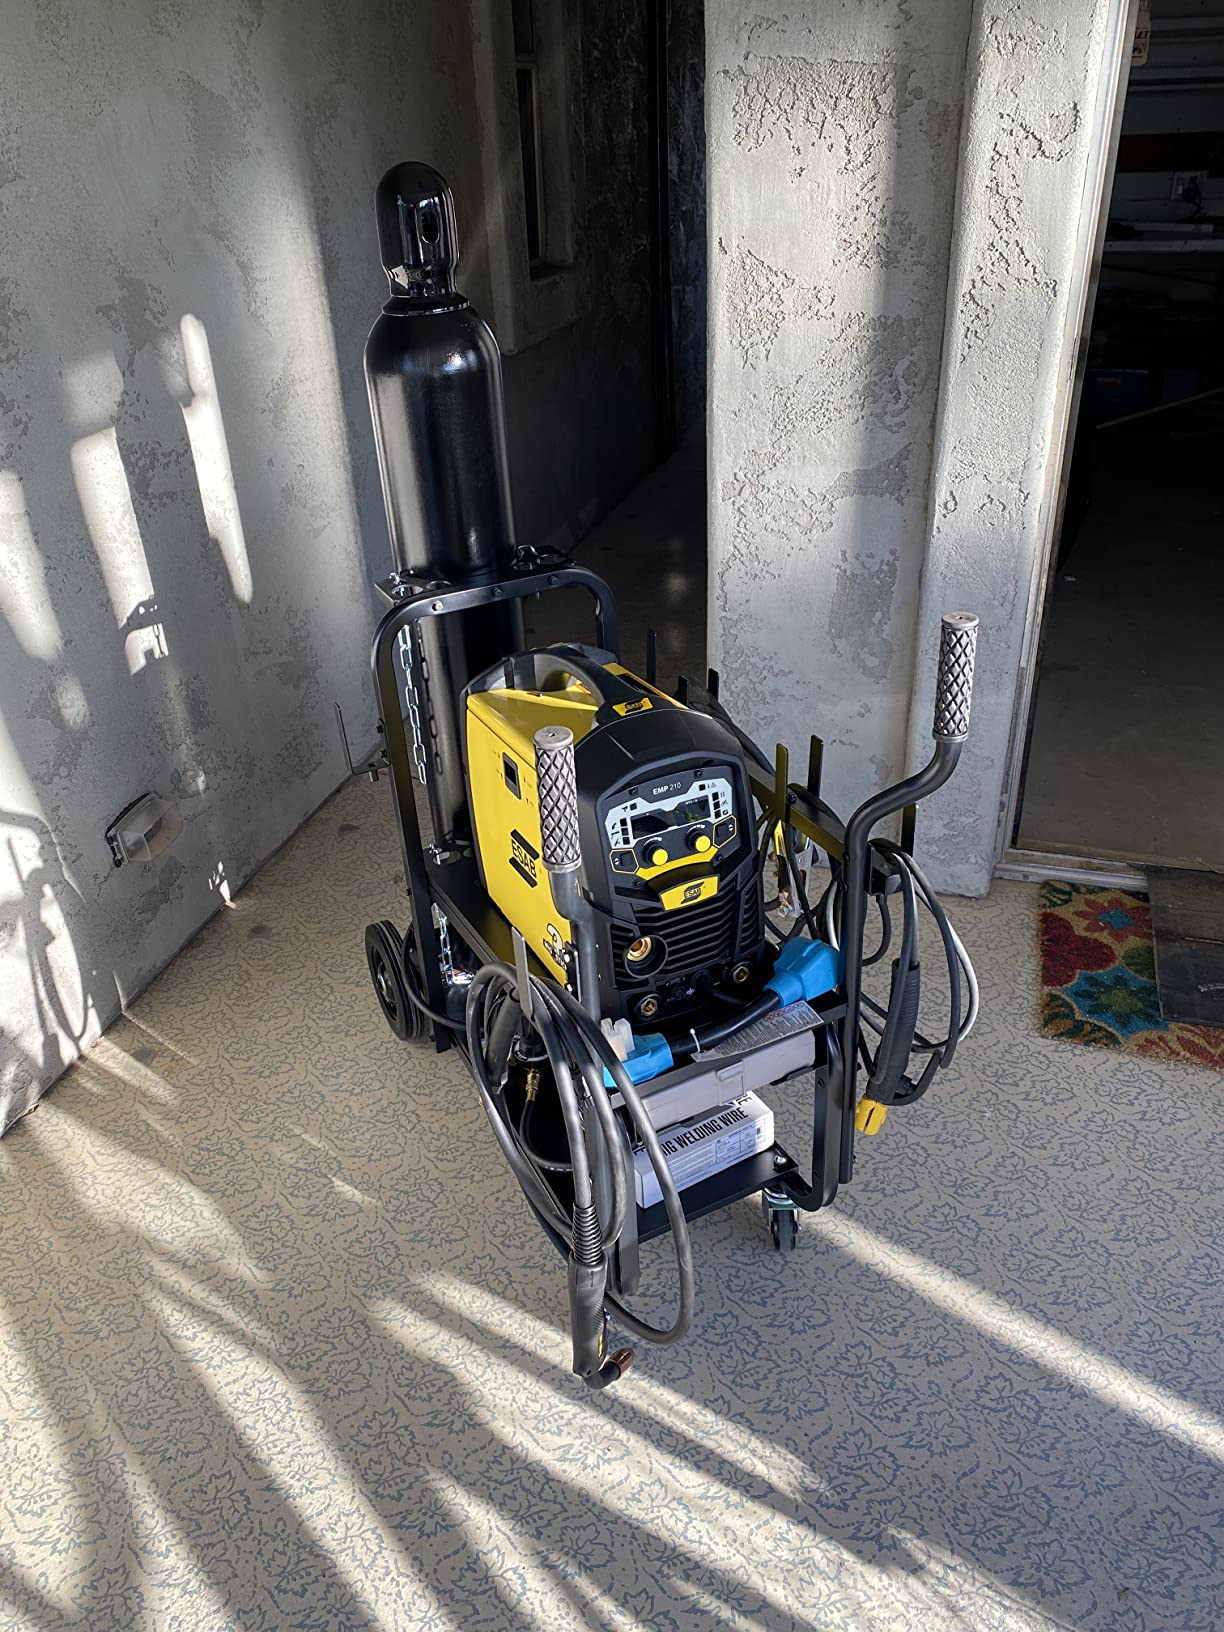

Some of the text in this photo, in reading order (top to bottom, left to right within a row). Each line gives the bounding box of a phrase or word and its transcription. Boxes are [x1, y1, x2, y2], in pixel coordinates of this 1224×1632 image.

[652, 781, 682, 795] EMP 210
[511, 838, 537, 878] ESAB
[684, 887, 702, 899] ESAB
[661, 1139, 678, 1156] IG
[673, 1118, 724, 1149] WELDING
[717, 1107, 749, 1127] WIRE
